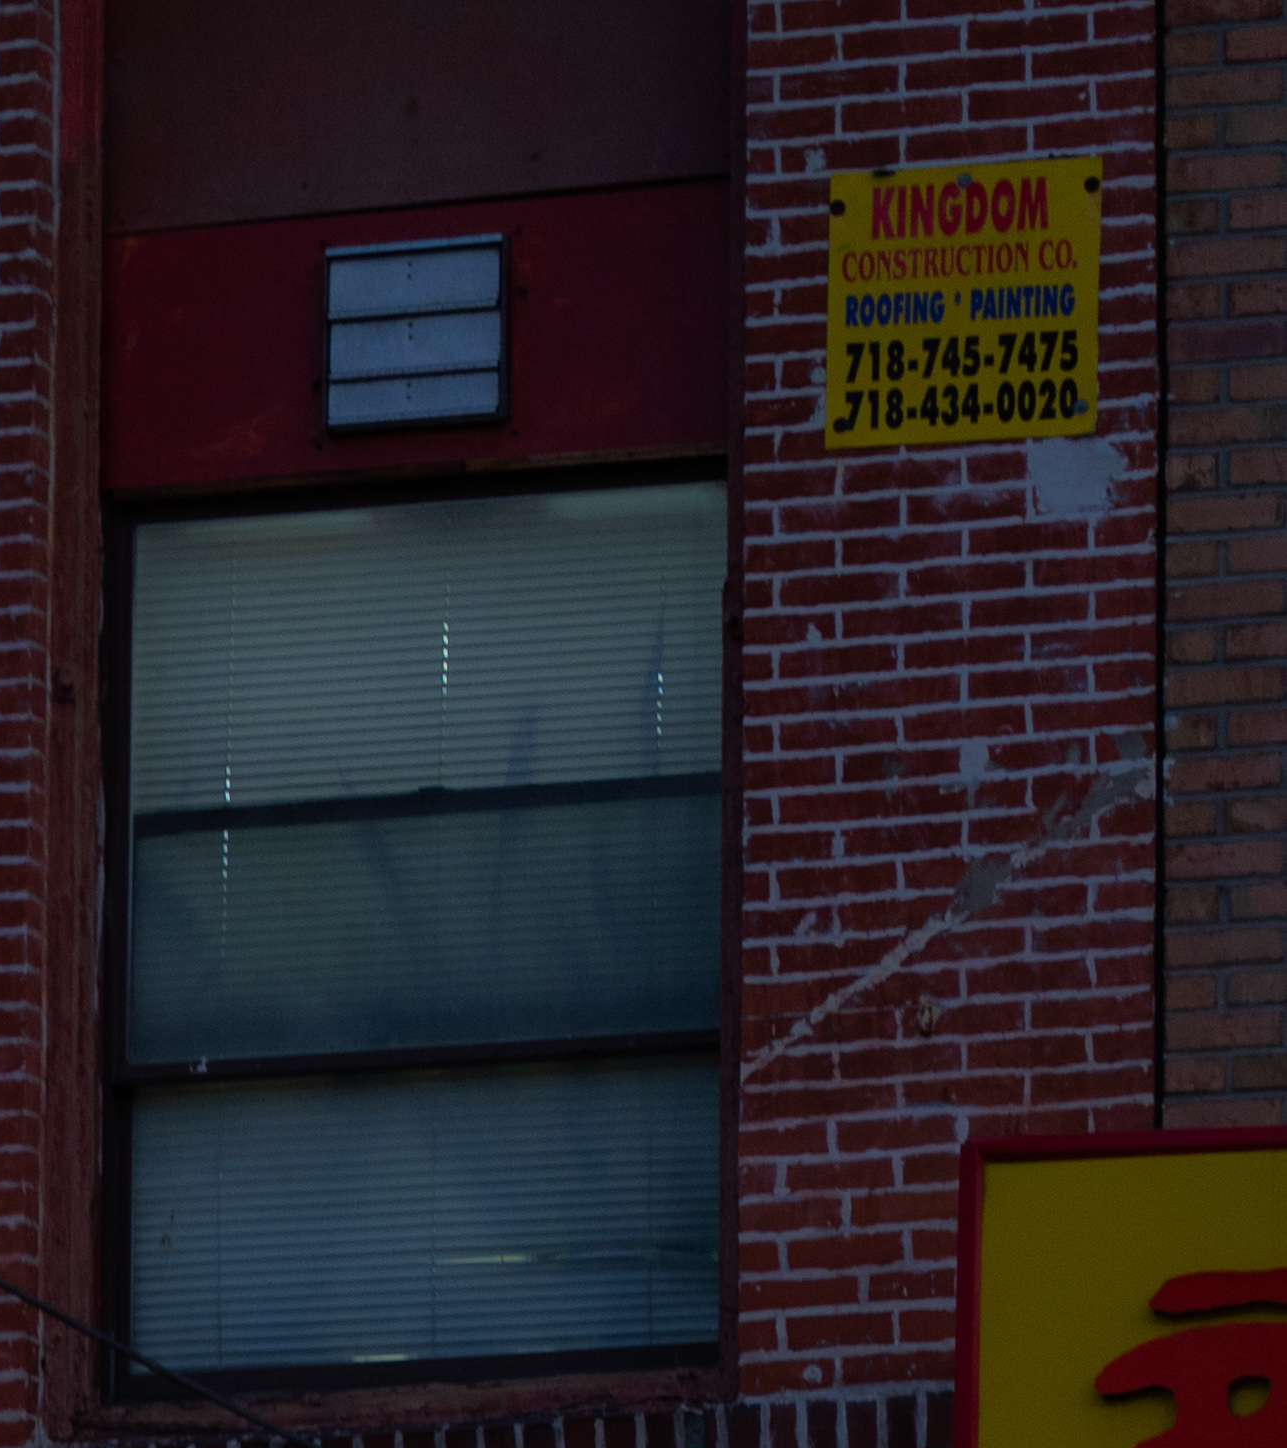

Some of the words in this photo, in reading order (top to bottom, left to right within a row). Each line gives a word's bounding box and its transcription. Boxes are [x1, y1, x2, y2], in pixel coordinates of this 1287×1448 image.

[871, 177, 1048, 240] KINGDOM
[842, 241, 1030, 282] CONSTRUCTION
[1038, 239, 1078, 271] CO.
[844, 291, 945, 327] ROOFING
[969, 283, 1076, 321] PAINTING
[845, 330, 1078, 383] 718-745-7475
[844, 379, 1079, 431] 718-434-0020
